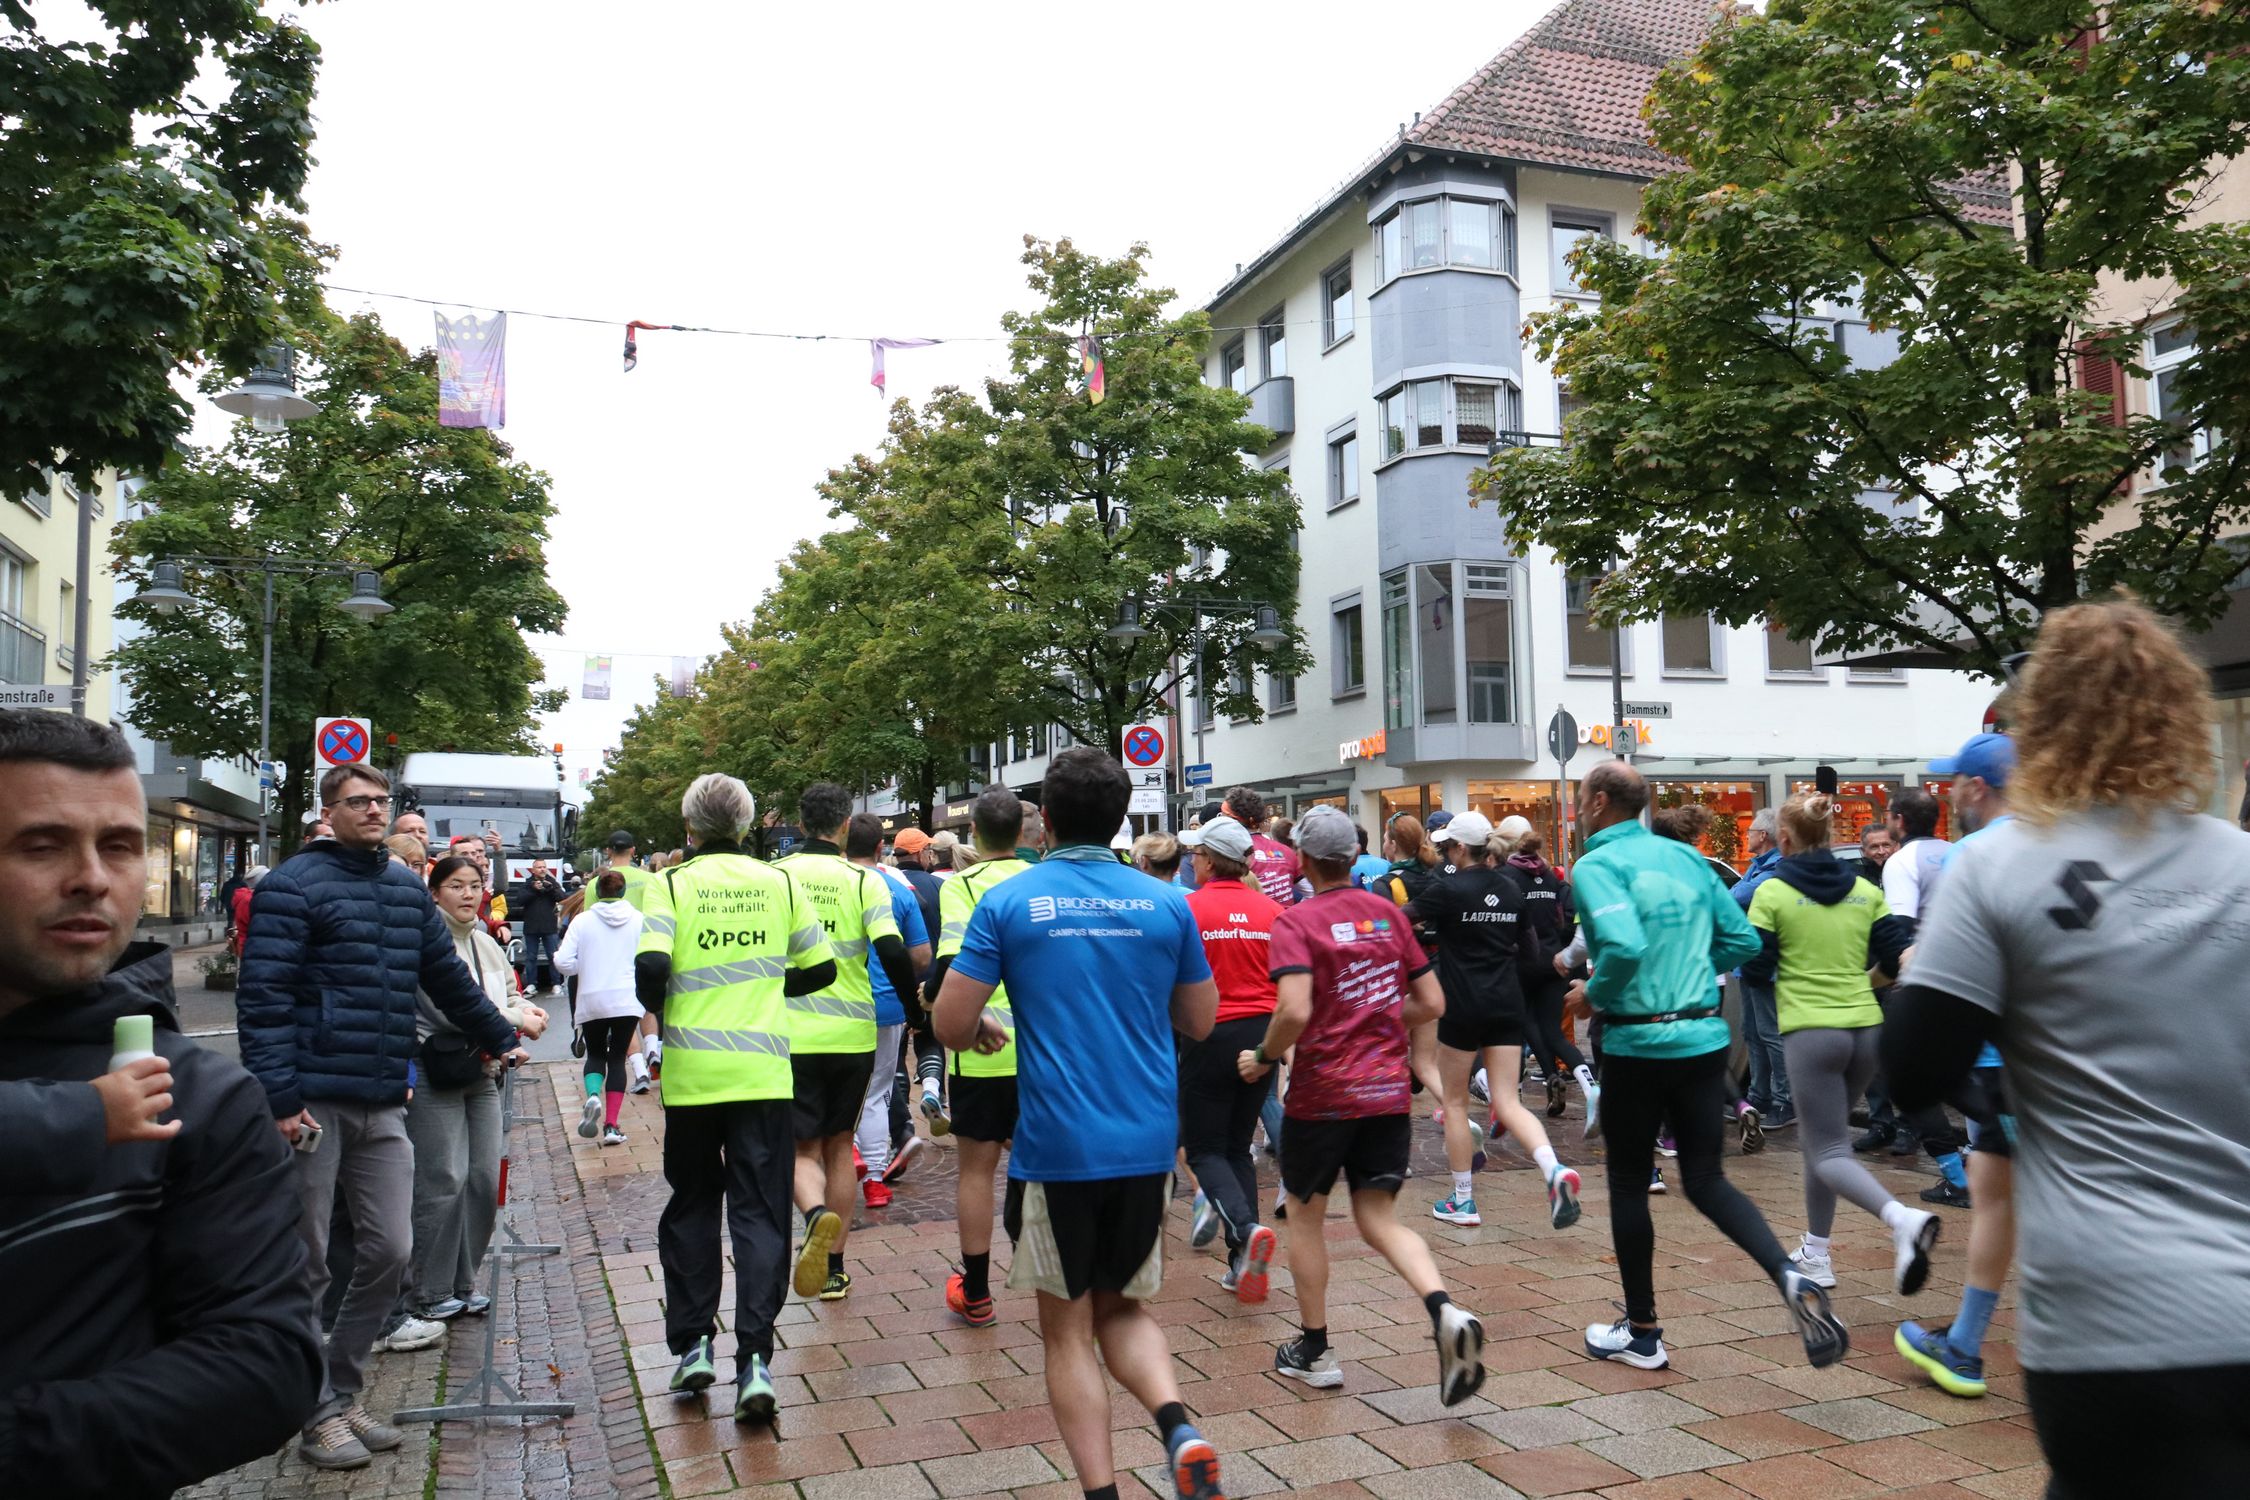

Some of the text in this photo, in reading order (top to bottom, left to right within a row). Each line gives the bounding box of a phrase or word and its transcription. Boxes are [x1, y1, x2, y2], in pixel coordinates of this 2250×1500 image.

[1626, 704, 1662, 715] Dammstr.
[697, 888, 770, 900] Workwear,
[698, 902, 769, 914] die auffällt.
[1056, 897, 1155, 911] BIOSENSORS
[1229, 913, 1248, 923] AXA
[722, 930, 766, 946] PCH
[1202, 928, 1238, 940] Ostdorf
